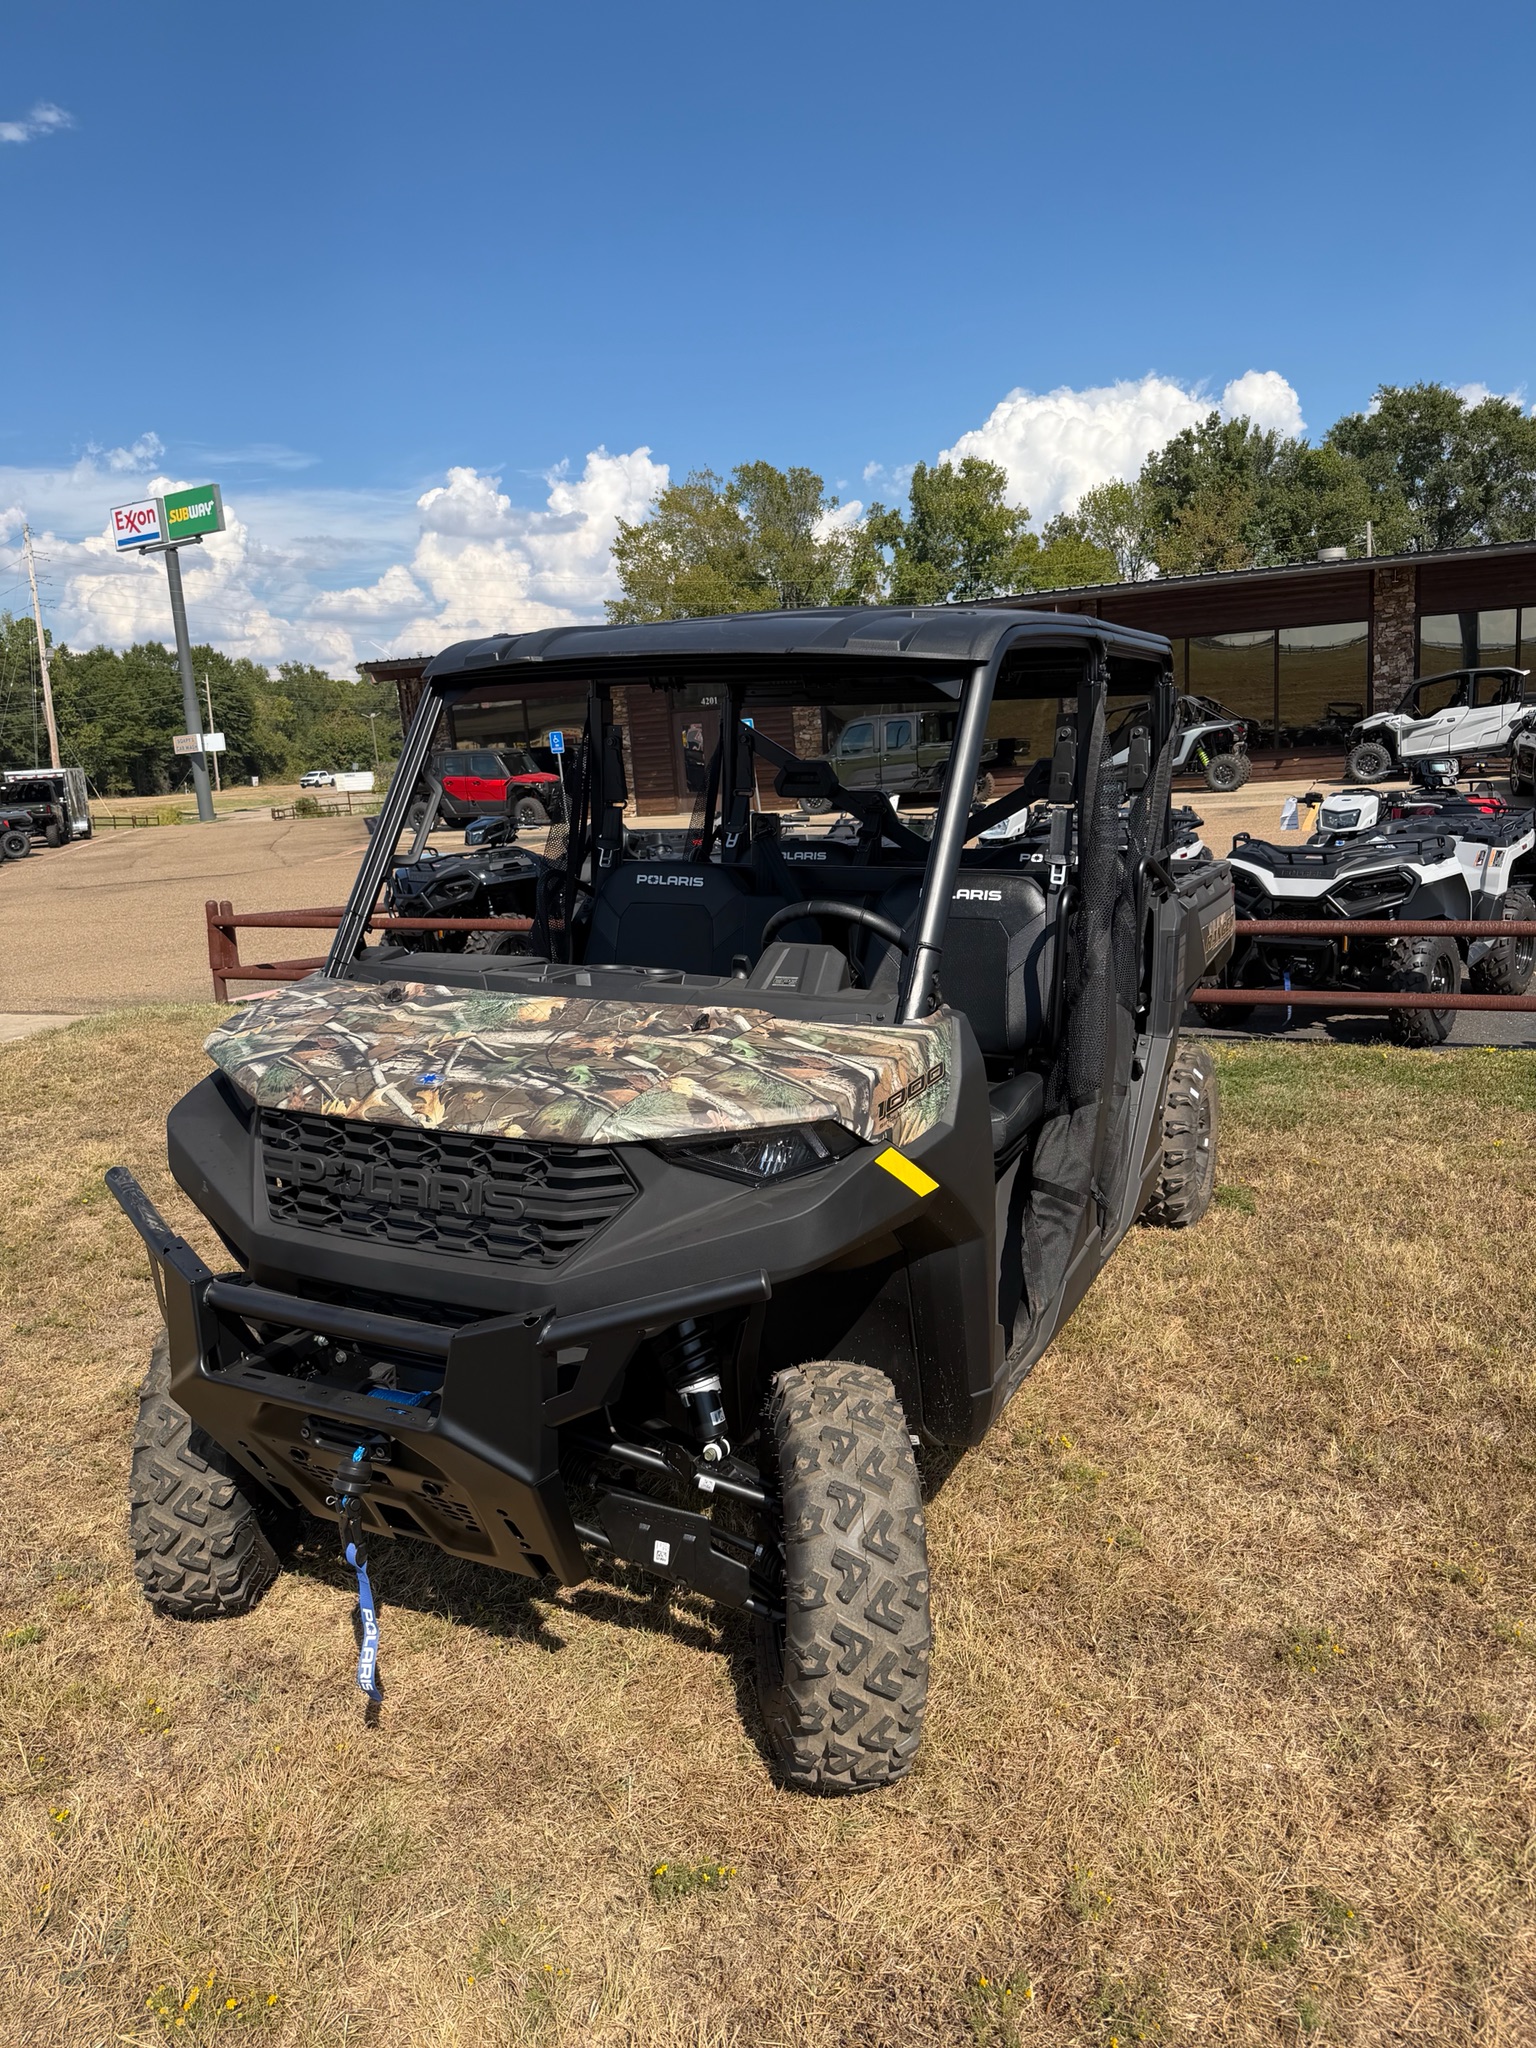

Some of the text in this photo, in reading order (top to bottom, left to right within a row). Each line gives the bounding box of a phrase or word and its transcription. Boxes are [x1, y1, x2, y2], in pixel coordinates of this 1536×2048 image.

[114, 508, 156, 533] Exxon
[168, 500, 214, 524] SUBWAY
[700, 696, 718, 705] 4201
[781, 851, 827, 860] LARIS
[636, 874, 704, 887] POLARIS
[952, 889, 1002, 901] ARIS
[877, 1061, 946, 1121] 1000
[290, 1150, 526, 1220] POLARIS
[360, 1608, 377, 1691] POLARIS
